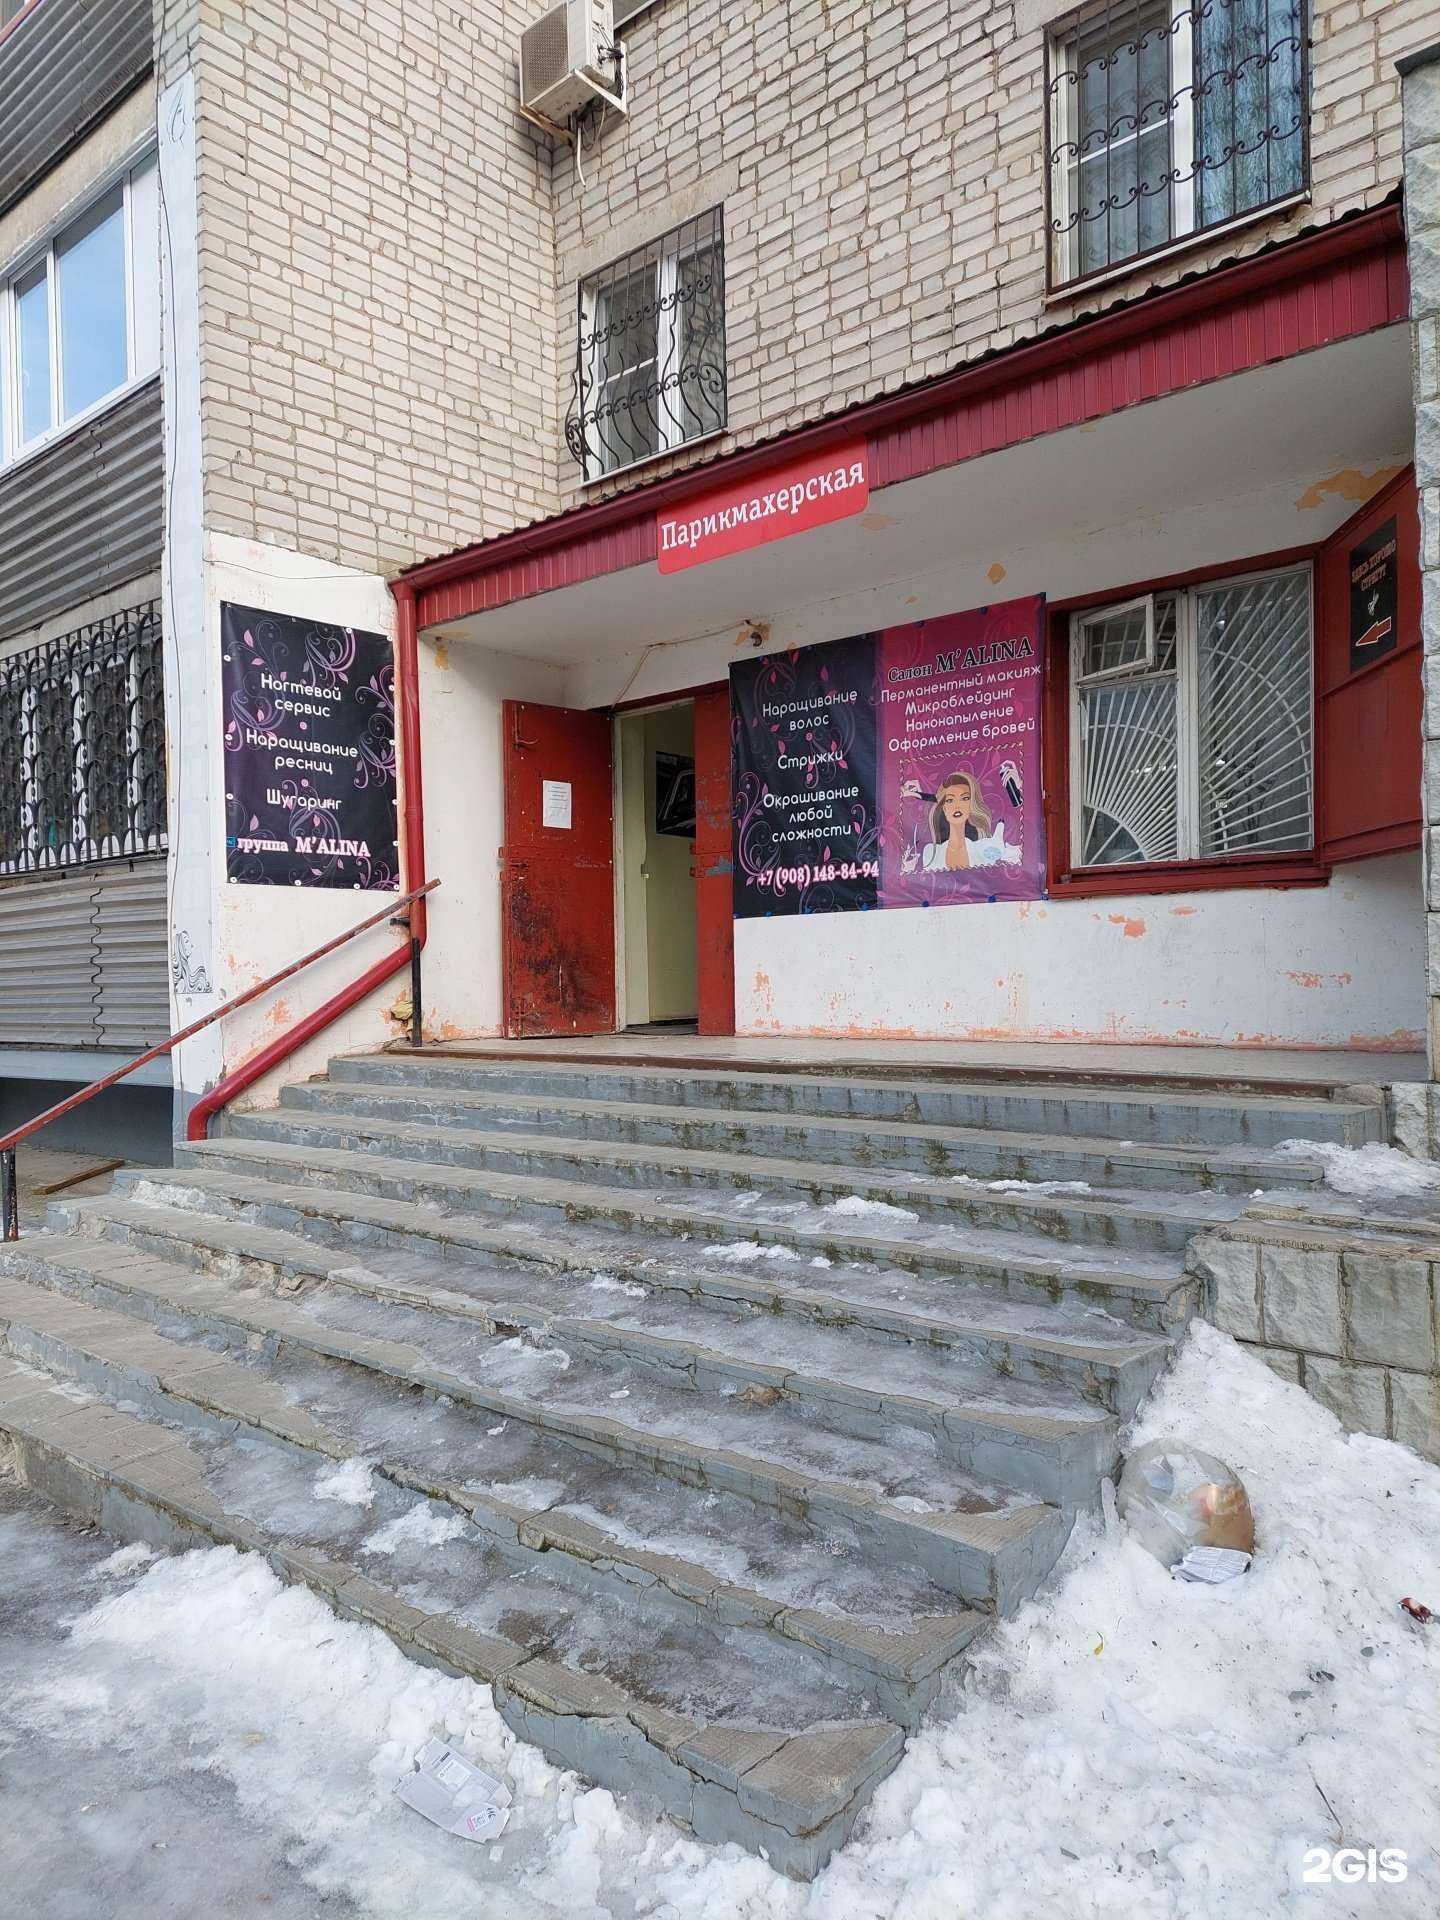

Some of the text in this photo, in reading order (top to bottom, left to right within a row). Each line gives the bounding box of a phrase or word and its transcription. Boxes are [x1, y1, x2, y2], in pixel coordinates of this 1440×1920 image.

[661, 462, 865, 551] Парикмахерская
[881, 663, 1042, 704] Перманентный макияж
[888, 663, 933, 684] Салон
[261, 672, 342, 701] Ногтевой
[274, 699, 331, 718] сервис
[762, 688, 859, 719] Наращивание
[904, 687, 1016, 717] Микроблейдинг
[789, 713, 830, 732] волос
[905, 705, 1015, 733] Нанонапыление
[245, 728, 359, 759] Наращивание
[888, 718, 1036, 753] Оформление бровей
[274, 755, 333, 776] ресниц
[777, 749, 844, 772] Стрижки
[266, 788, 342, 810] Шугаринг
[763, 785, 860, 810] Окрашивание
[788, 804, 834, 824] любой
[236, 836, 289, 854] группа
[771, 824, 852, 844] сложности
[758, 860, 880, 889] +7 (908) 148-84-94
